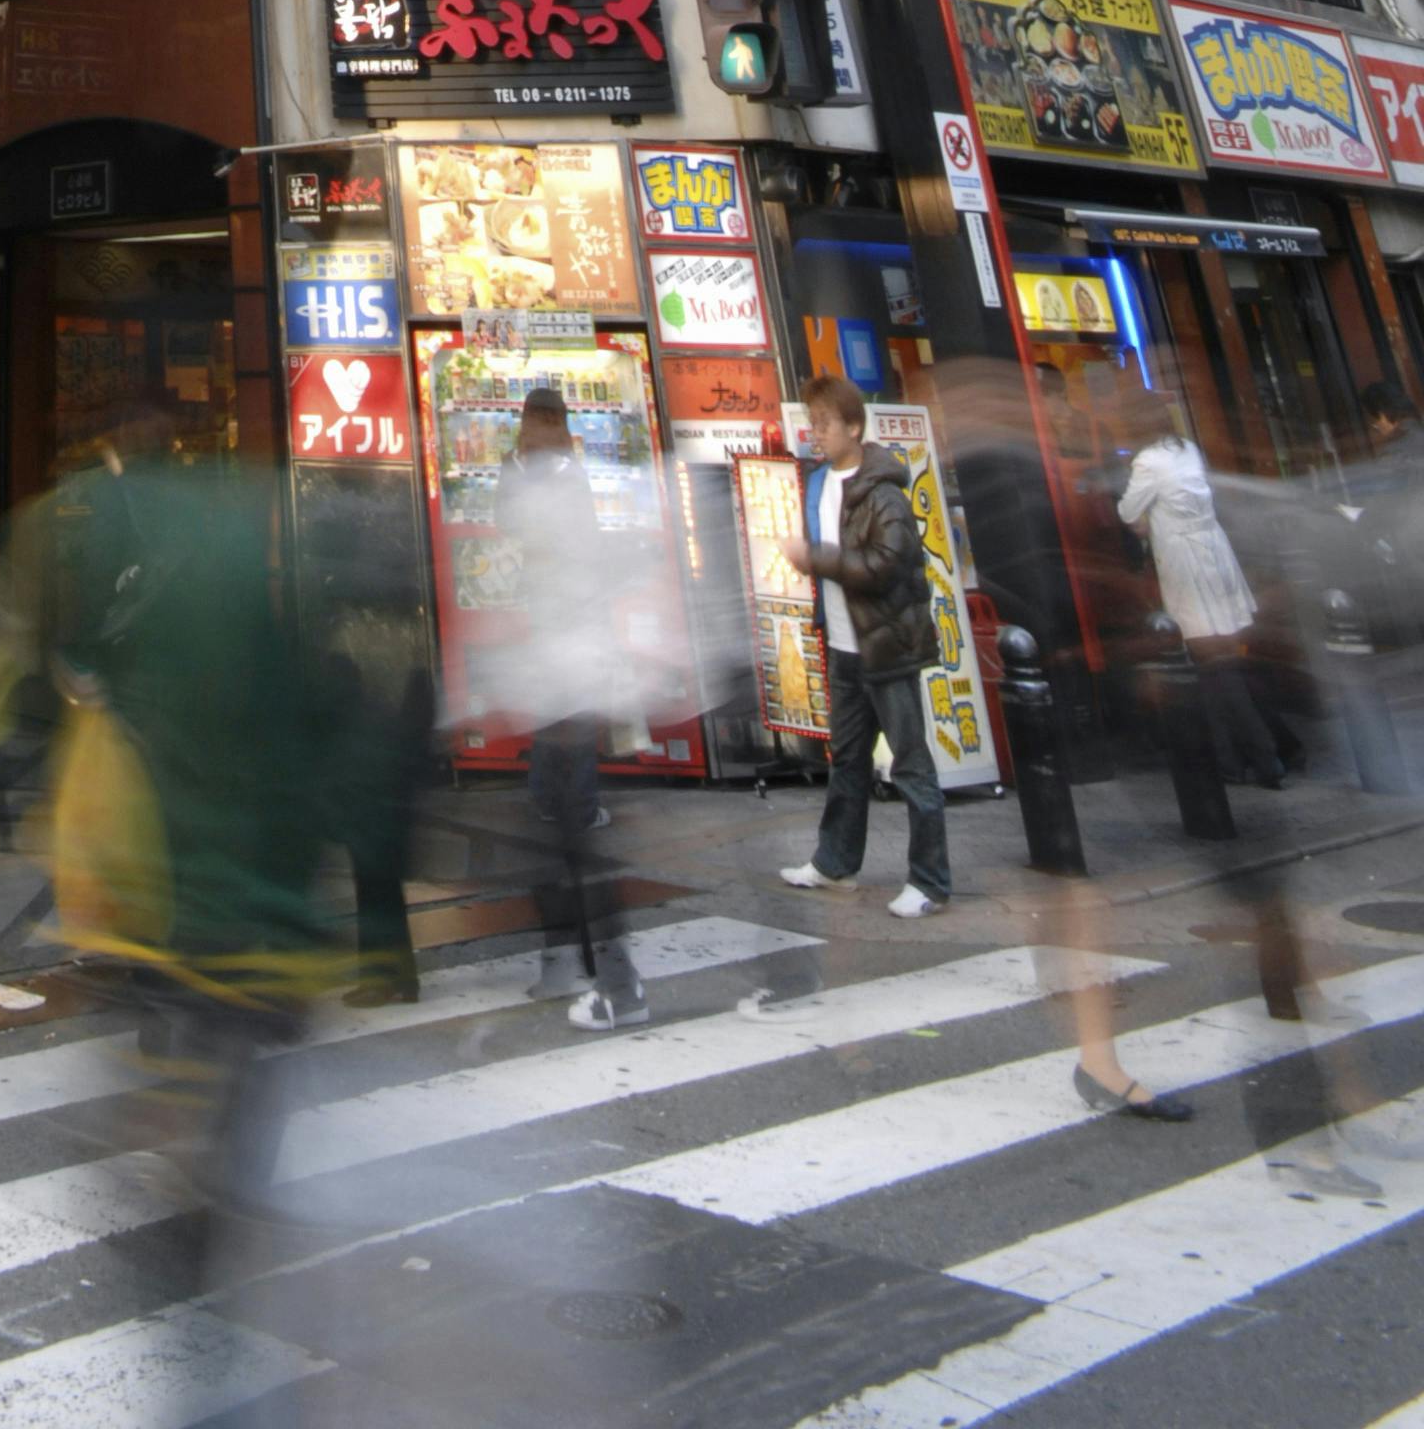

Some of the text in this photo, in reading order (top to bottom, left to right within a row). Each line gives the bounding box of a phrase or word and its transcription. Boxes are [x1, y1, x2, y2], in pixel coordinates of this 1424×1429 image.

[494, 87, 517, 103] TEL
[1193, 26, 1352, 126] まんが喫茶
[1164, 116, 1189, 166] 5F
[643, 160, 734, 208] まんが
[297, 411, 405, 455] アイフル
[673, 428, 705, 439] INDIAN
